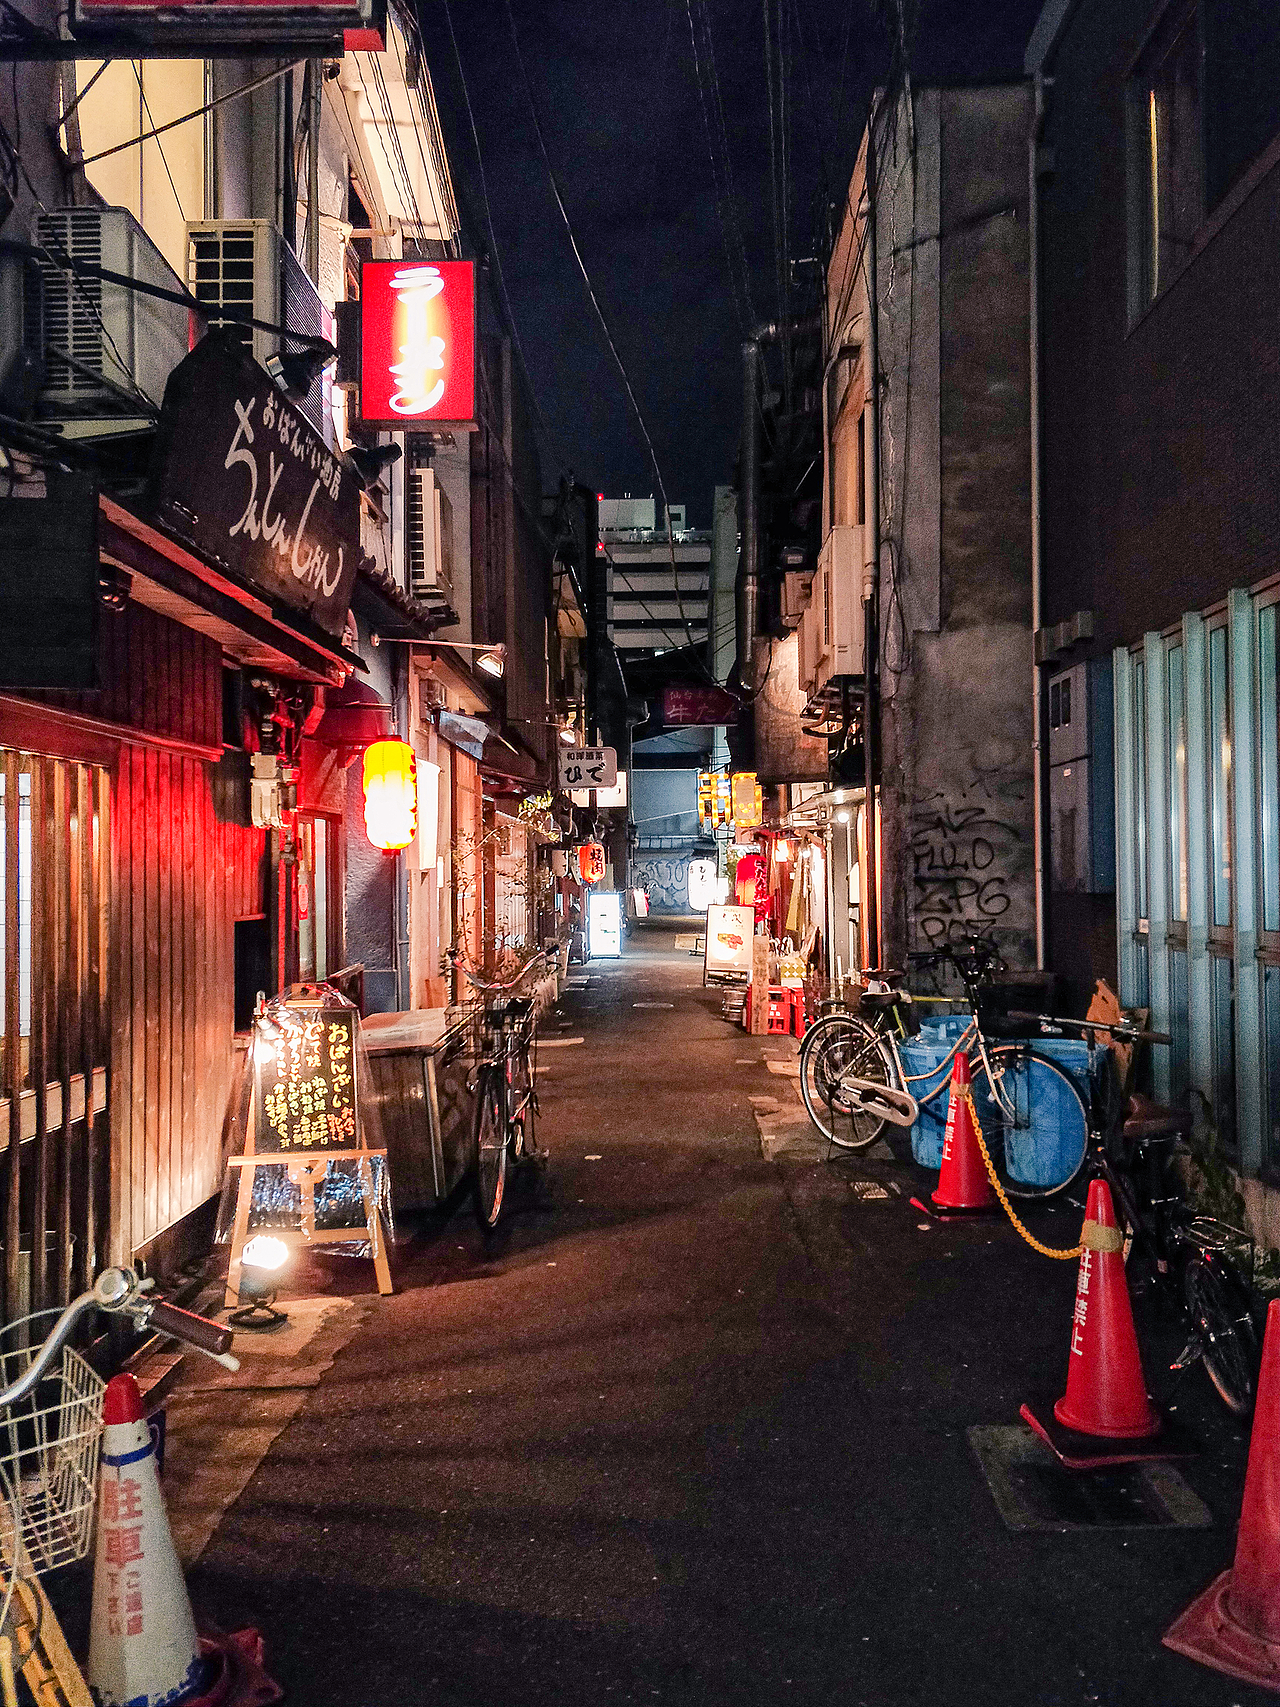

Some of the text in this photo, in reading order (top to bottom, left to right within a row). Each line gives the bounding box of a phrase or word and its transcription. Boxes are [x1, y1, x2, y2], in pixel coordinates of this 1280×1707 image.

[564, 761, 606, 783] ひで
[328, 1022, 351, 1108] おばんざい
[102, 1478, 145, 1568] 駐車
